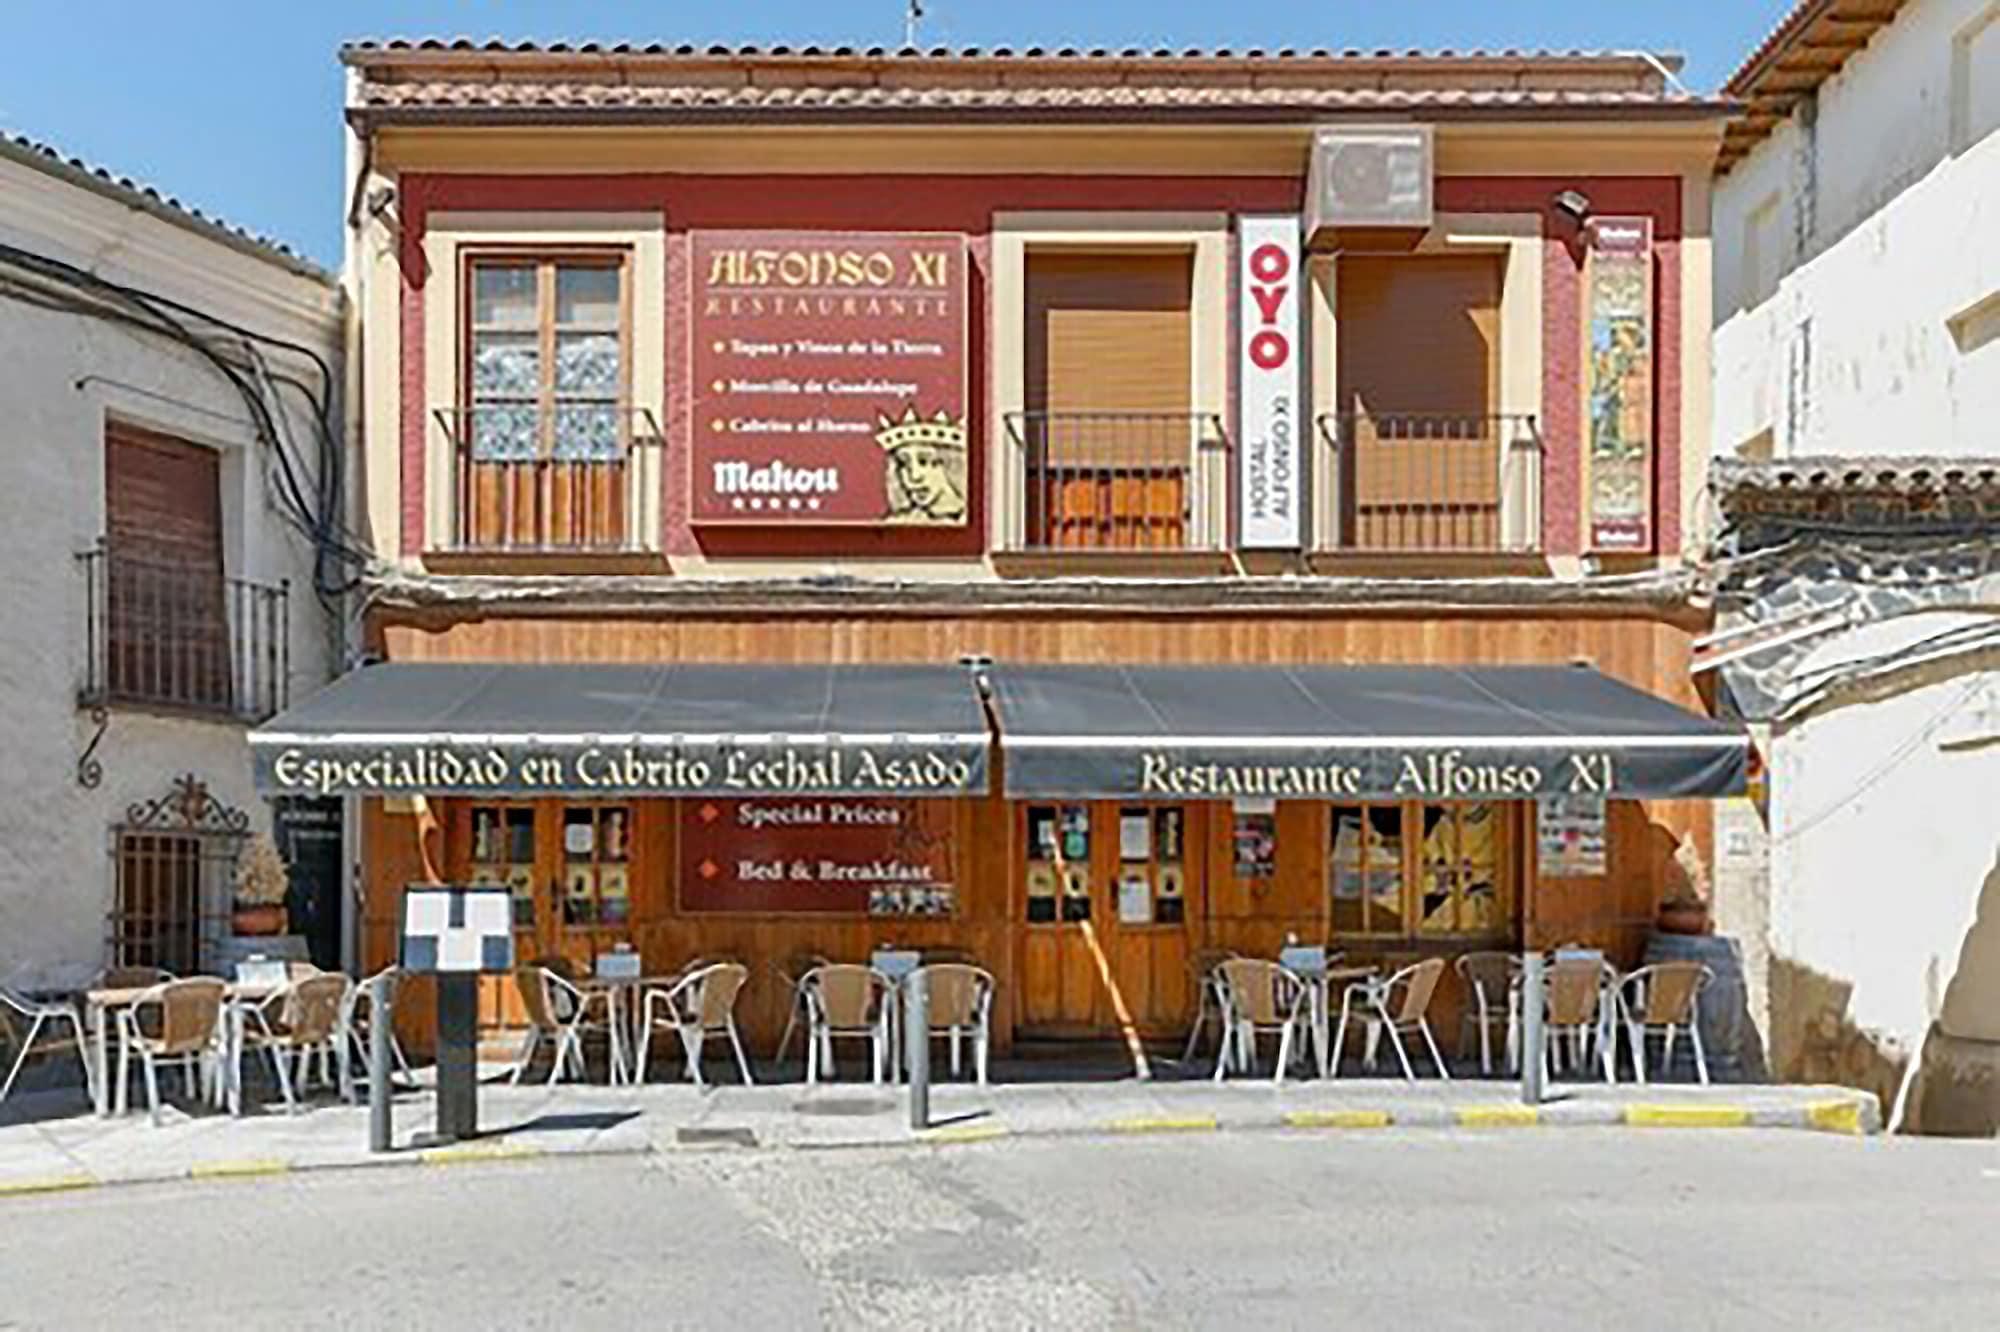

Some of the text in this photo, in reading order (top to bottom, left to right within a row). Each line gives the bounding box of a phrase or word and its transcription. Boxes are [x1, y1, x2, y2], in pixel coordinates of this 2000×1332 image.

[707, 251, 948, 286] ALFONSO XI
[705, 298, 948, 316] RESTAURANTE
[1249, 243, 1290, 371] OYO
[713, 460, 839, 493] Mahou
[1249, 439, 1267, 519] HOSTAL
[1271, 420, 1291, 518] ALFONSO
[274, 749, 969, 793] Especialidad en Cabrito Lechal Asado
[1142, 750, 1612, 796] Restaurante Alfonso XI
[737, 803, 899, 828] Special Prices
[737, 860, 933, 881] Bed & Breakfast
